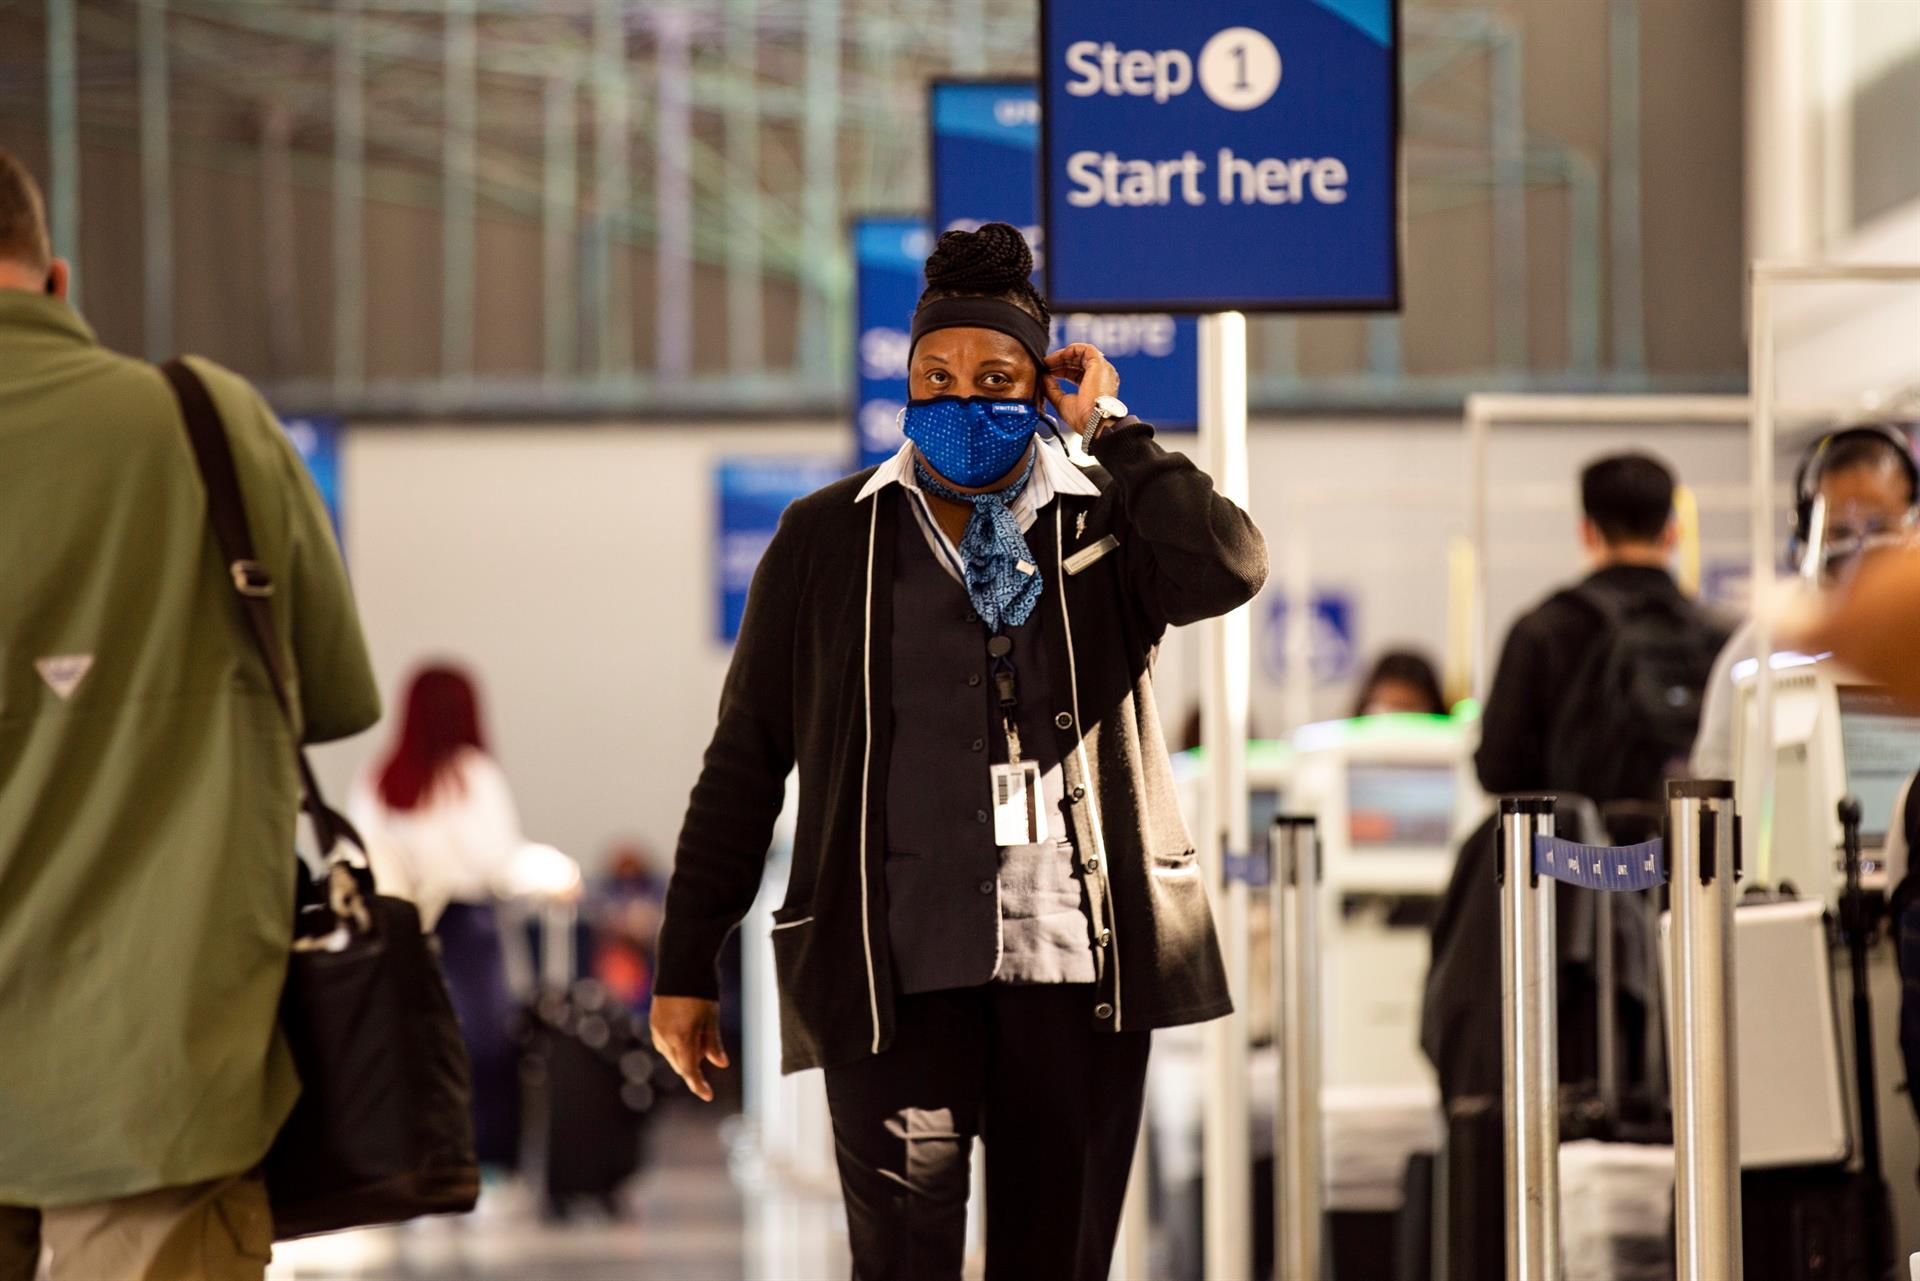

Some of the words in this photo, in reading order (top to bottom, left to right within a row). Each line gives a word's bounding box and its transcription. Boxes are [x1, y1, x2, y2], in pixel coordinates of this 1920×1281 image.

[1066, 41, 1192, 102] Step
[1066, 151, 1205, 206] Start
[1217, 148, 1348, 204] here
